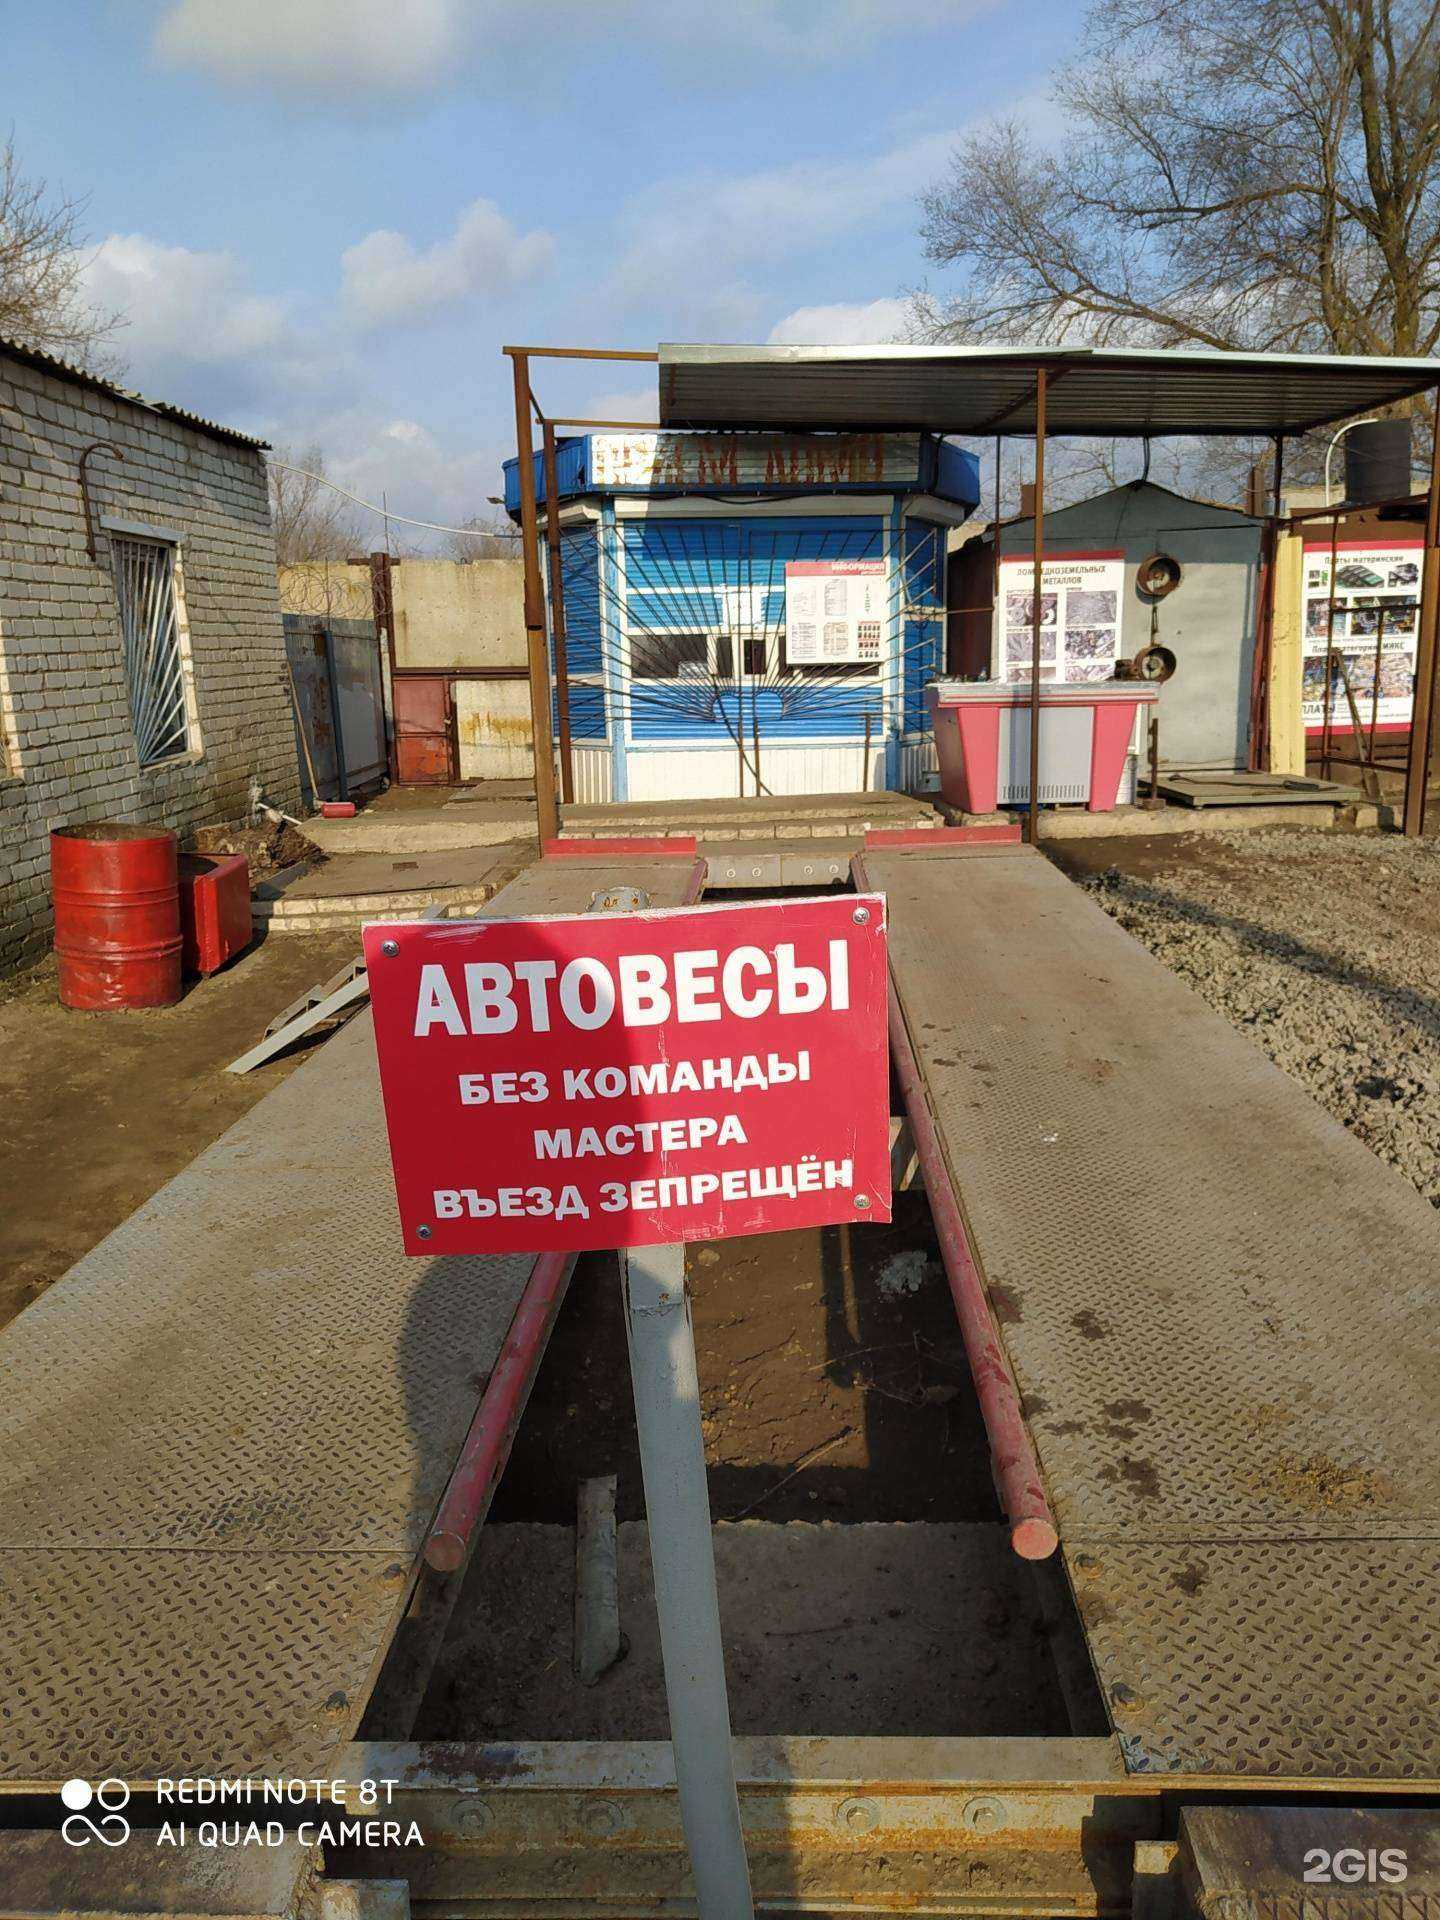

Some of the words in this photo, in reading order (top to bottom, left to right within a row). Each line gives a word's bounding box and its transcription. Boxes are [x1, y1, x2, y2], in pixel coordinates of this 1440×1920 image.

[1042, 577, 1082, 585] МЕТАЛЛОВ
[414, 939, 850, 1037] АВТОВЕСЫ
[457, 1071, 549, 1106] БЕЗ
[564, 1050, 811, 1101] КОМАНДЫ
[533, 1114, 748, 1160] МАСТЕРА
[433, 1185, 589, 1220] ВЪЕЗД
[600, 1155, 854, 1211] ЗЕПРЕЩЁН
